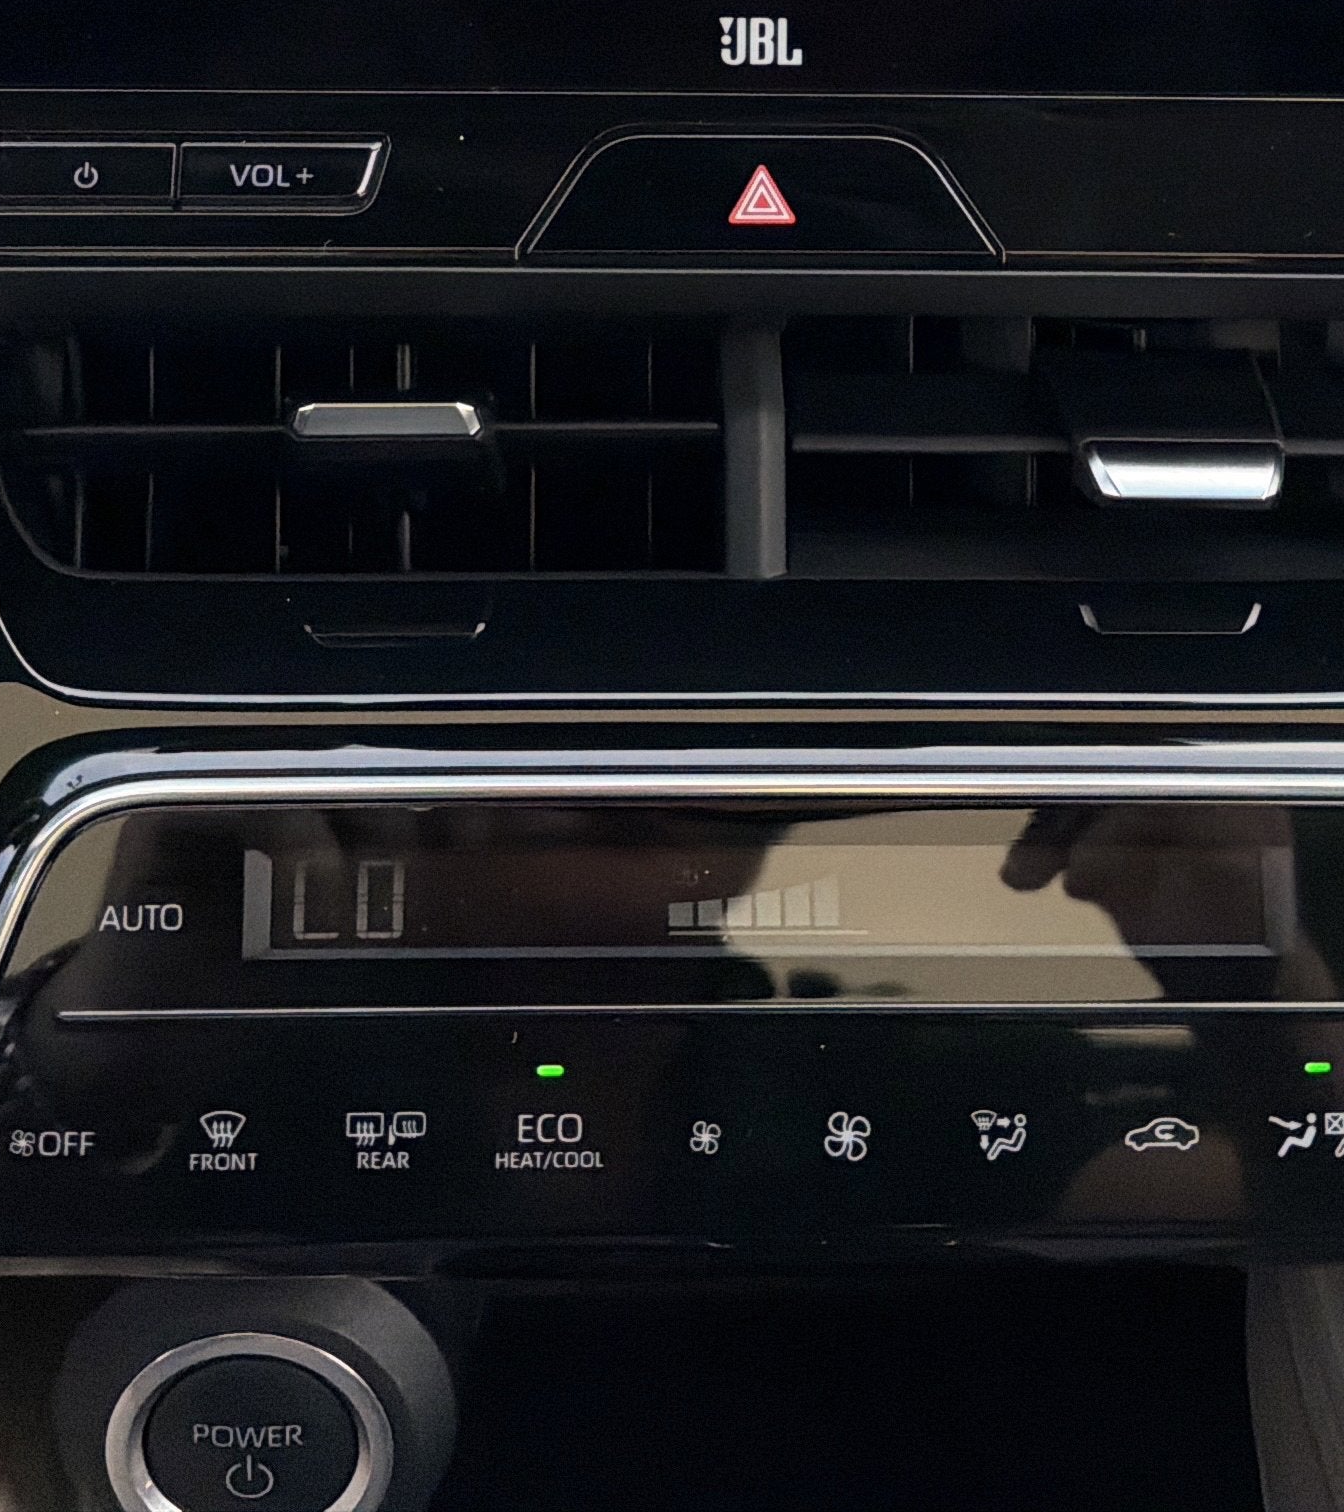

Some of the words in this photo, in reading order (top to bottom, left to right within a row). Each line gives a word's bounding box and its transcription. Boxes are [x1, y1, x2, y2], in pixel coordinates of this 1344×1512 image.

[719, 17, 803, 66] JBL
[99, 904, 184, 933] AUTO
[518, 1114, 583, 1143] ECO
[38, 1131, 96, 1157] OFF
[189, 1152, 258, 1172] FRONT
[356, 1151, 411, 1170] REAR
[495, 1150, 605, 1170] HEAT/COOL
[193, 1424, 304, 1449] POWER
